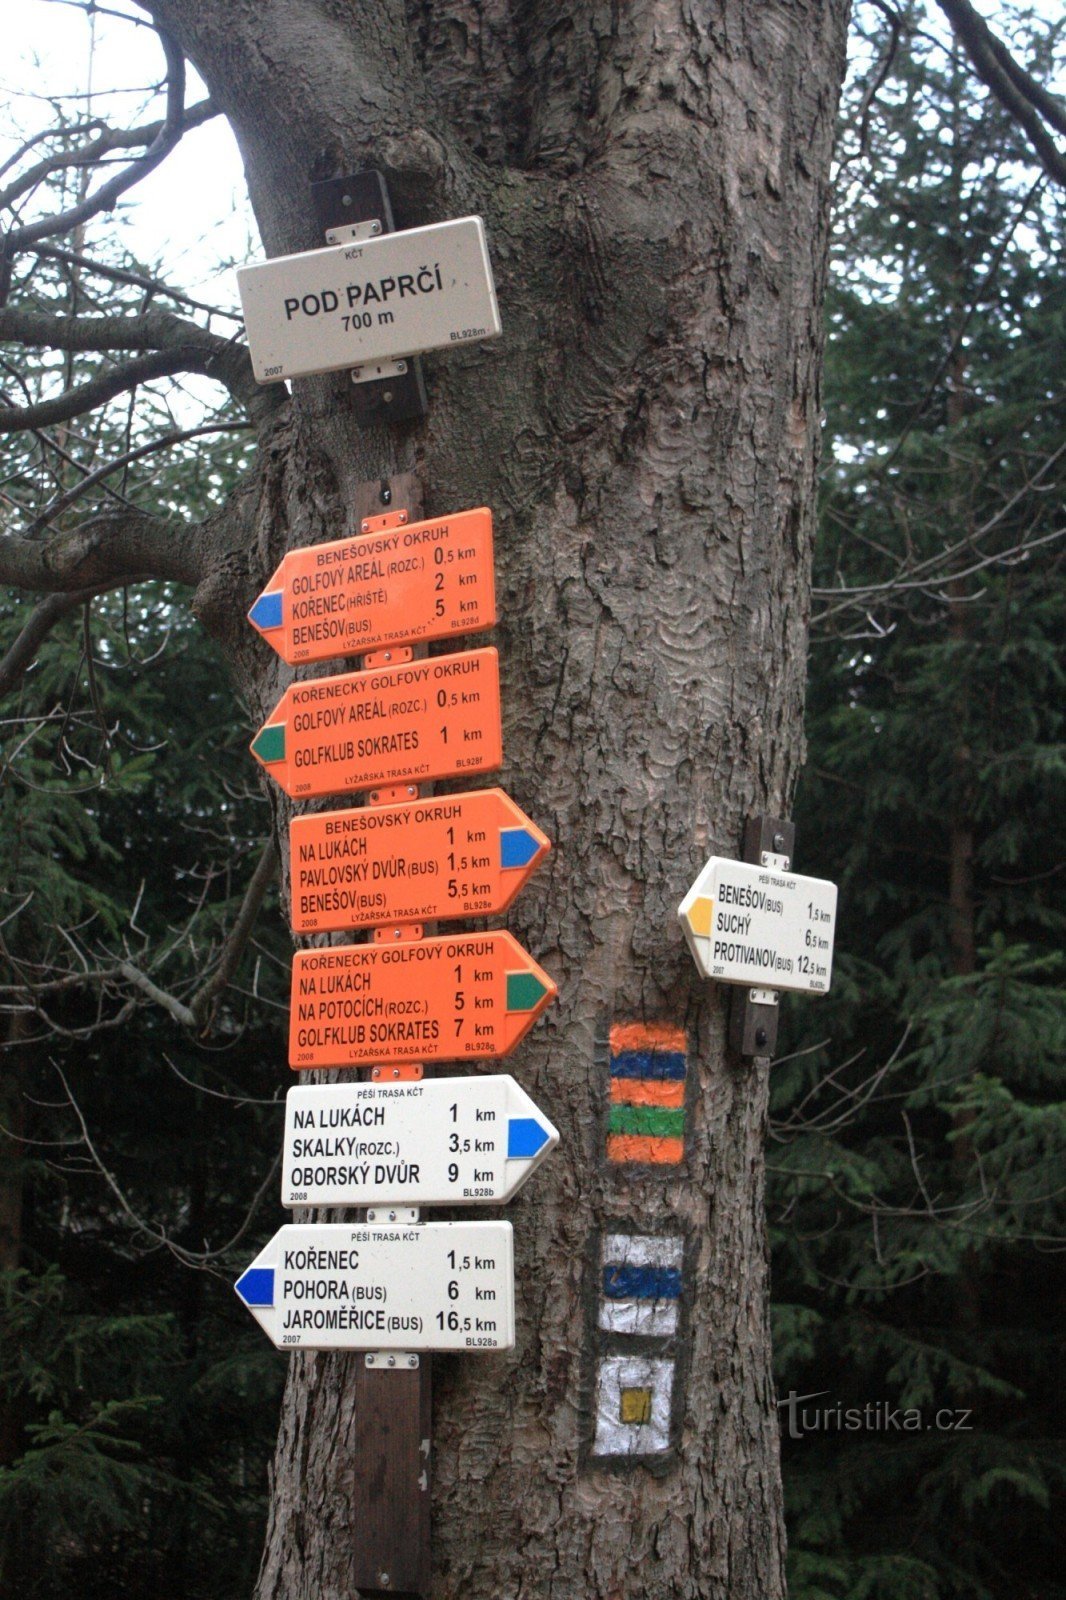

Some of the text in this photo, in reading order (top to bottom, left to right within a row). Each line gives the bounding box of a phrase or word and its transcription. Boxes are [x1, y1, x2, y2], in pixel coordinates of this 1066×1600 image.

[345, 248, 363, 260] KČT
[284, 263, 443, 320] POD PAPRČÍ
[342, 311, 394, 332] 700 m
[450, 328, 486, 340] BL928m
[264, 366, 283, 377] 2007
[317, 527, 449, 566] BENEŠOVSKÝ OKRUH
[293, 547, 475, 594] GOLFOVÝ AREÁL (ROZC.) 0,5 km
[435, 573, 444, 591] 2
[459, 573, 477, 586] km
[435, 599, 445, 617] 5
[460, 600, 478, 613] km
[451, 617, 479, 629] BL928d
[384, 628, 410, 641] TRASA
[411, 625, 426, 636] KČT
[371, 667, 429, 691] GOLFOVÝ
[434, 659, 480, 679] OKRUH
[294, 689, 480, 732] GOLFOVÝ AREÁL (ROZC.) 0,5 km
[295, 726, 482, 767] GOLFKLUB SOKRATES 1 km
[386, 767, 413, 778] TRASA
[414, 764, 430, 775] KČT
[456, 756, 483, 768] BL928f
[295, 783, 311, 792] 2008
[326, 805, 462, 835] BENEŠOVSKÝ OKRUH
[300, 826, 486, 862] NA LUKÁCH 1 km
[300, 860, 369, 888] PAVLOVSKÝ
[447, 852, 468, 872] 1,5
[472, 856, 490, 868] km
[448, 879, 469, 898] 5,5
[472, 882, 491, 896] km
[770, 878, 786, 887] TRASA
[394, 908, 420, 917] TRASA
[421, 905, 438, 914] KČT
[463, 901, 492, 911] BL928e
[808, 902, 819, 922] 1,5
[820, 911, 831, 923] km
[301, 918, 318, 927] 2008
[717, 912, 829, 949] SUCHÝ 6,5 km
[301, 942, 494, 971] KOŘENECKÝ GOLFOVÝ OKRUH
[797, 956, 815, 974] 12,5
[816, 965, 827, 976] km
[713, 966, 724, 974] 2007
[300, 965, 493, 995] NA LUKÁCH 1 km
[299, 1004, 315, 1021] NA
[319, 994, 383, 1020] POTOCÍCH
[455, 992, 465, 1011] 5
[475, 997, 494, 1009] km
[298, 1018, 494, 1047] GOLFKLUB SOKRATES 7 km
[298, 1053, 314, 1061] 2008
[393, 1046, 421, 1055] TRASA
[422, 1044, 438, 1054] KČT
[358, 1087, 423, 1100] PĚŠÍ TRASA KČT
[294, 1103, 495, 1129] NA LUKÁCH 1 km
[449, 1134, 471, 1154] 3,5
[475, 1138, 495, 1152] km
[291, 1160, 494, 1186] OBORSKÝ DVŮR 9 km
[290, 1192, 307, 1201] 2008
[463, 1188, 494, 1197] BL928b
[351, 1232, 419, 1241] PĚŠÍ TRASA KČT
[284, 1246, 495, 1272] KOŘENEC 1,5 km
[283, 1280, 496, 1302] POHORA (BUS) 6 km
[436, 1311, 471, 1333] 16,5
[476, 1318, 496, 1331] km
[282, 1335, 301, 1344] 2007
[465, 1337, 498, 1347] BL928a
